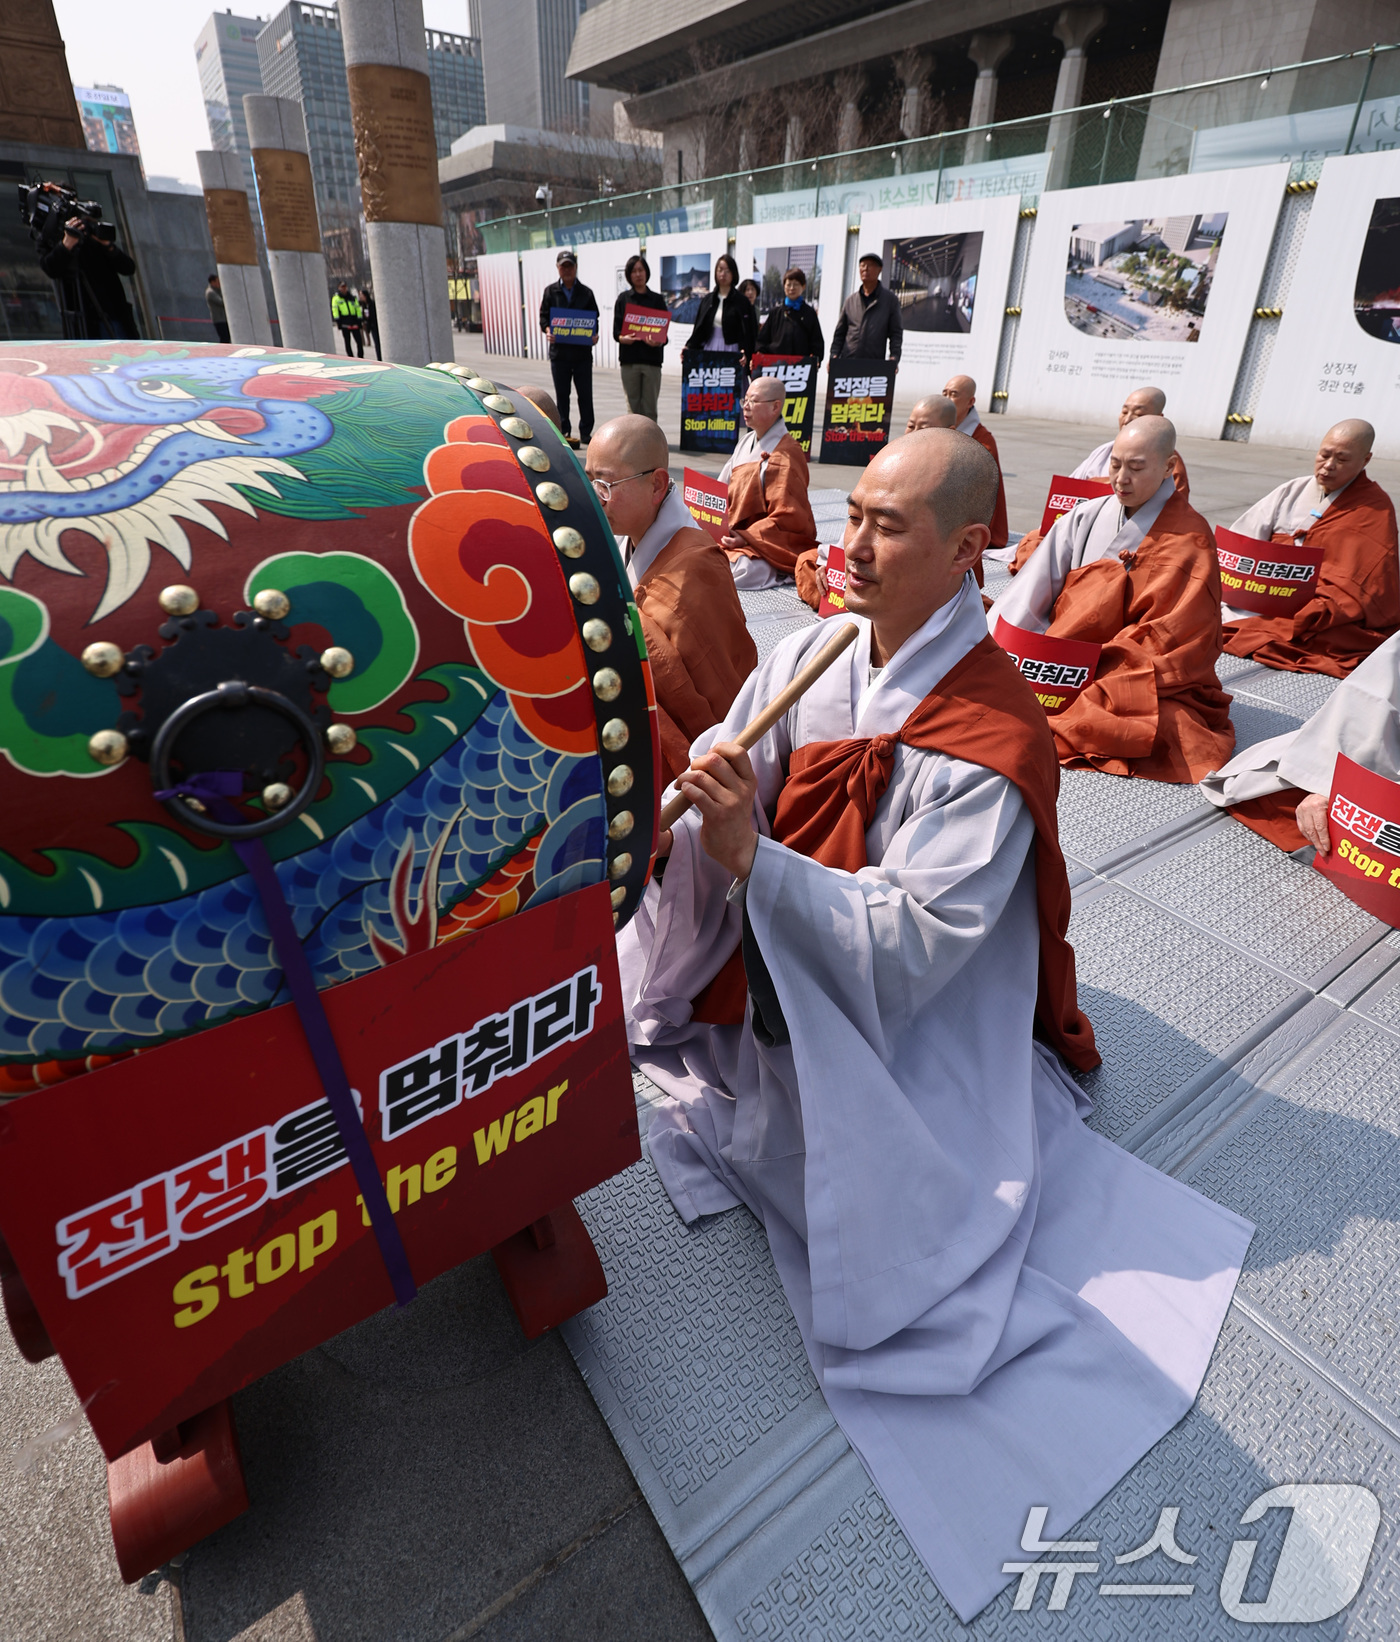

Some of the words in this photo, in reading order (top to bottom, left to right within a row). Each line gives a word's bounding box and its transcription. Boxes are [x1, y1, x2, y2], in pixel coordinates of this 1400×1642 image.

[552, 326, 570, 337] Stop
[571, 327, 593, 337] killing
[688, 367, 736, 387] 살생을
[1068, 364, 1082, 376] 공간
[1323, 362, 1357, 376] 상징적
[834, 376, 888, 398] 전쟁을
[1318, 379, 1340, 392] 경관
[1343, 381, 1365, 395] 연출
[687, 392, 735, 412] 멈춰라
[781, 397, 808, 424] 대
[830, 402, 885, 423] 멈춰라
[684, 418, 706, 431] Stop
[707, 418, 736, 431] killing
[825, 430, 848, 442] Stop
[849, 430, 866, 442] the
[867, 432, 886, 442] war
[685, 486, 704, 506] 전쟁을
[704, 493, 727, 513] 멈춰라
[701, 510, 711, 522] the
[711, 515, 723, 526] war
[1217, 548, 1255, 575] 전쟁을
[1254, 560, 1315, 582] 멈춰라
[827, 567, 847, 591] 전쟁
[1220, 571, 1243, 589] Stop
[1244, 580, 1267, 594] the
[1268, 586, 1297, 597] war
[828, 592, 845, 609] Stop
[1020, 658, 1089, 688] 멈춰라
[1338, 838, 1385, 878] Stop
[56, 1088, 363, 1300] 전쟁을
[379, 965, 602, 1142] 멈춰라
[173, 1209, 338, 1328] Stop
[473, 1078, 569, 1166] war
